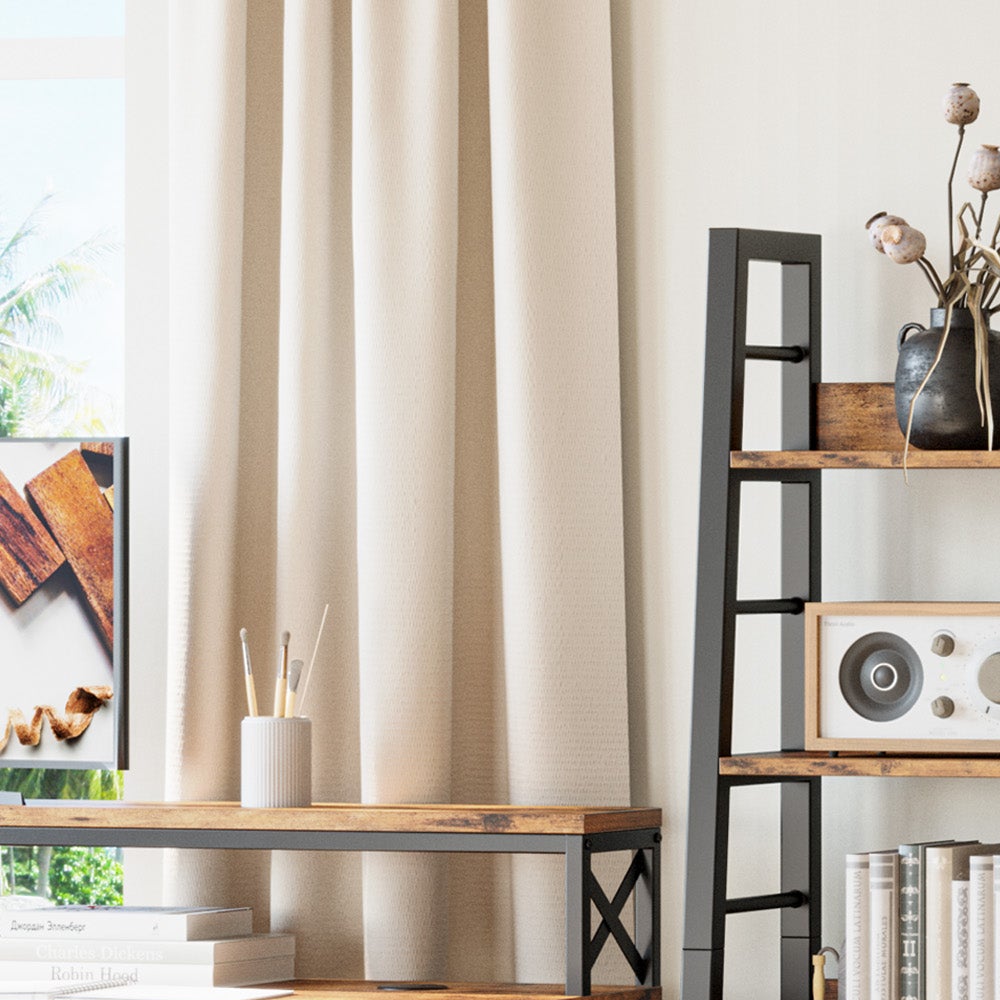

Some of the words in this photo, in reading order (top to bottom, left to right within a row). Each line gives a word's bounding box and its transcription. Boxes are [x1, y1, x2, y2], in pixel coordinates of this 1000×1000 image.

[10, 920, 45, 932] Джордан
[35, 943, 97, 961] Charles
[100, 945, 163, 962] Dickens
[50, 965, 94, 981] Robin
[100, 966, 139, 983] Hood
